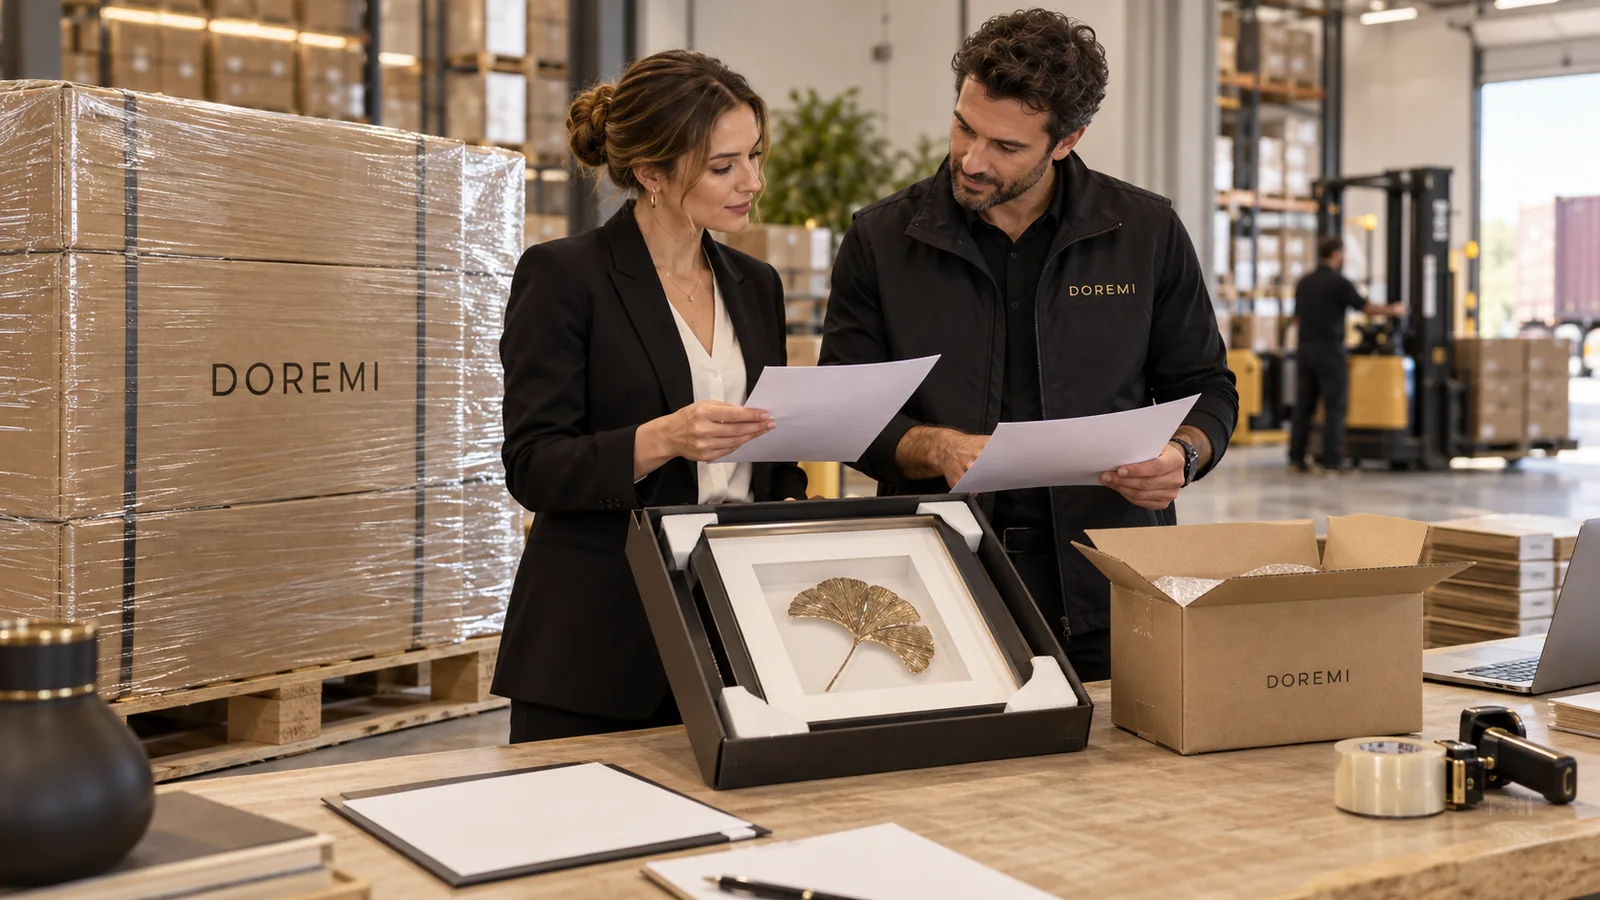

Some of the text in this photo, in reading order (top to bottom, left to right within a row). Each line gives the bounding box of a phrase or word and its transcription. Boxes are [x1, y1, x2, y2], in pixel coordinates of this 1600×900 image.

[1069, 283, 1136, 297] DOREMI
[211, 361, 379, 397] DOREMI
[1267, 669, 1349, 689] DOREMI
